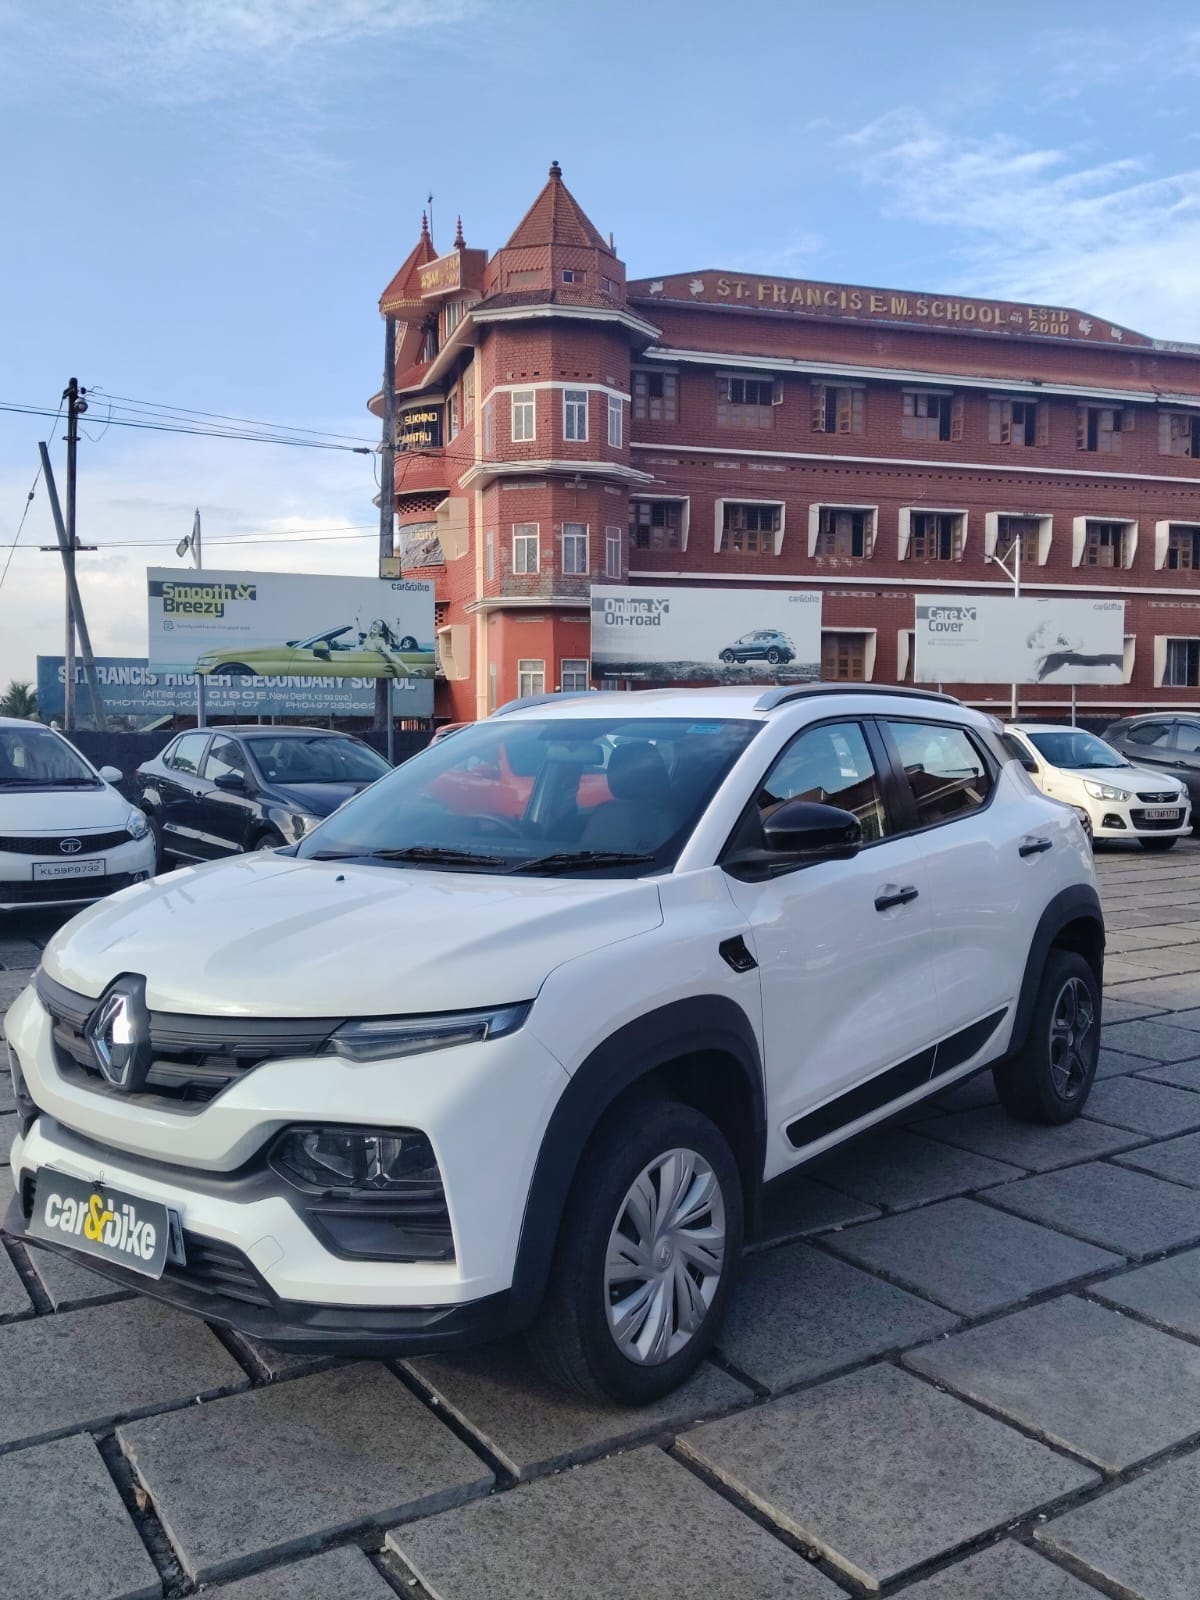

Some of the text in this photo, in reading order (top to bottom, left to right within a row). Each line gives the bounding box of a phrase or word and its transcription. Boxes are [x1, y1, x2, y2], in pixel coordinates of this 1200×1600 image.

[717, 278, 750, 299] ST.
[758, 283, 863, 310] FRANCIS
[1028, 307, 1069, 322] ESTD
[1029, 320, 1069, 335] 2000
[162, 582, 256, 600] Smooth &
[391, 582, 430, 592] car&bike
[163, 598, 224, 618] Breezy
[604, 598, 669, 614] Online &
[604, 612, 661, 626] On-road
[928, 607, 976, 621] Care &
[928, 619, 964, 632] Cover
[44, 1193, 157, 1260] car&bike
